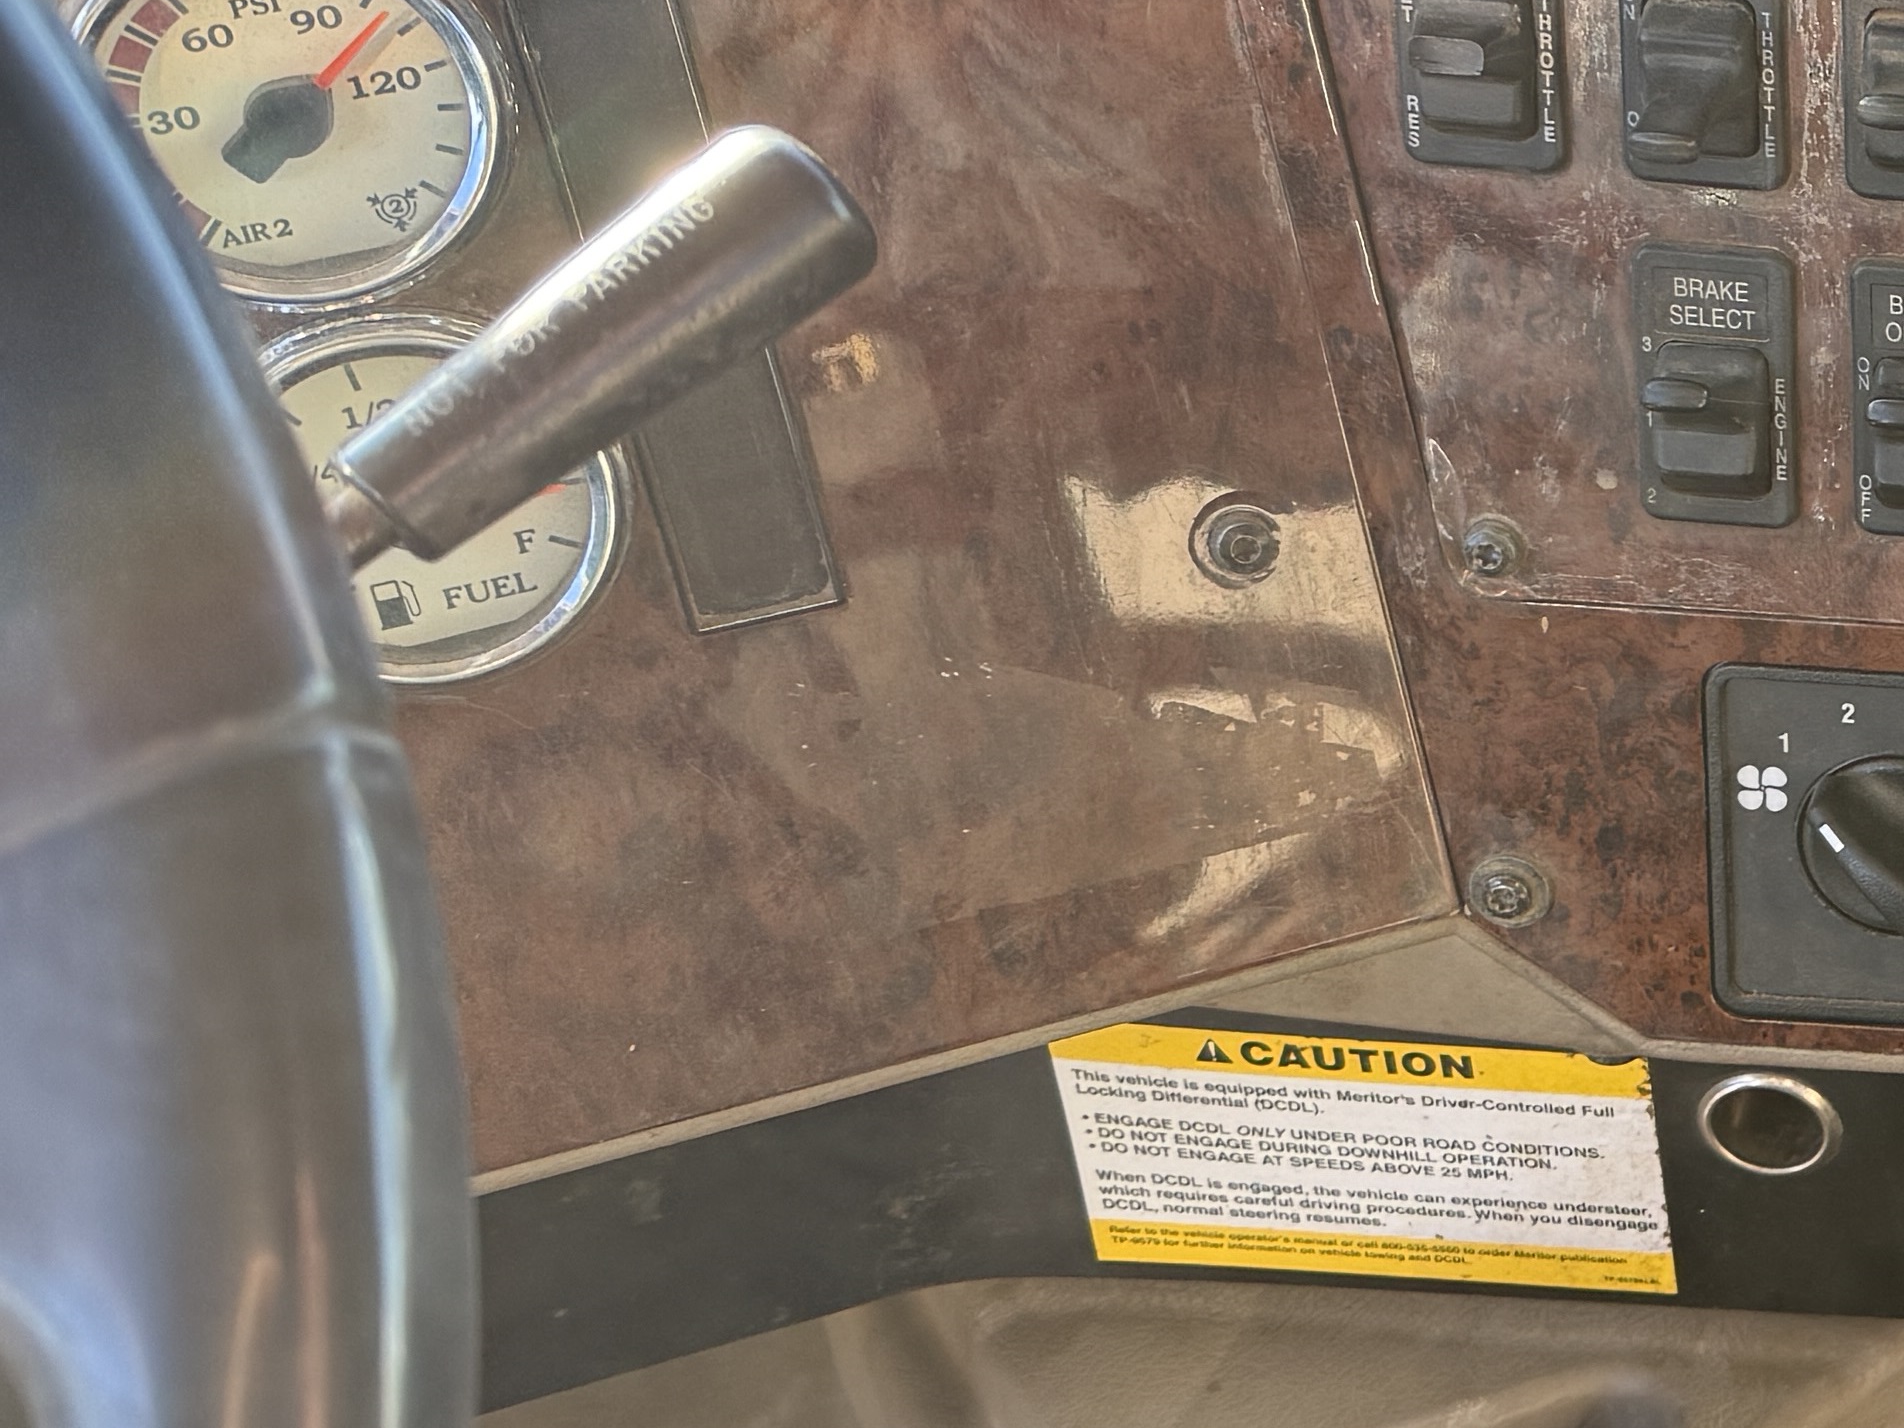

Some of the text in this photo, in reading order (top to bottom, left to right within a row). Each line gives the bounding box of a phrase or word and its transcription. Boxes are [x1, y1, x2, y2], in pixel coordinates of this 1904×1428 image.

[289, 4, 342, 34] 90
[180, 23, 234, 54] 60
[347, 66, 421, 101] 120
[1761, 11, 1776, 159] THROTTLE
[146, 105, 200, 136] 30
[1407, 95, 1420, 148] RES
[222, 218, 294, 249] AIR 2
[563, 196, 714, 311] PARKING
[1672, 276, 1750, 304] BRAKE
[1669, 304, 1756, 332] SELECT
[1774, 378, 1788, 482] ENGINE
[513, 529, 536, 554] F
[442, 572, 538, 609] FUEL
[1841, 704, 1855, 725] 2
[1777, 732, 1790, 752] 1
[1239, 1040, 1475, 1079] CAUTION
[1075, 1084, 1325, 1115] Locking Differential (DCDL).
[1094, 1113, 1605, 1160] ENGAGE DCDL ONLY UNDER POOR ROAD CONDITIONS.
